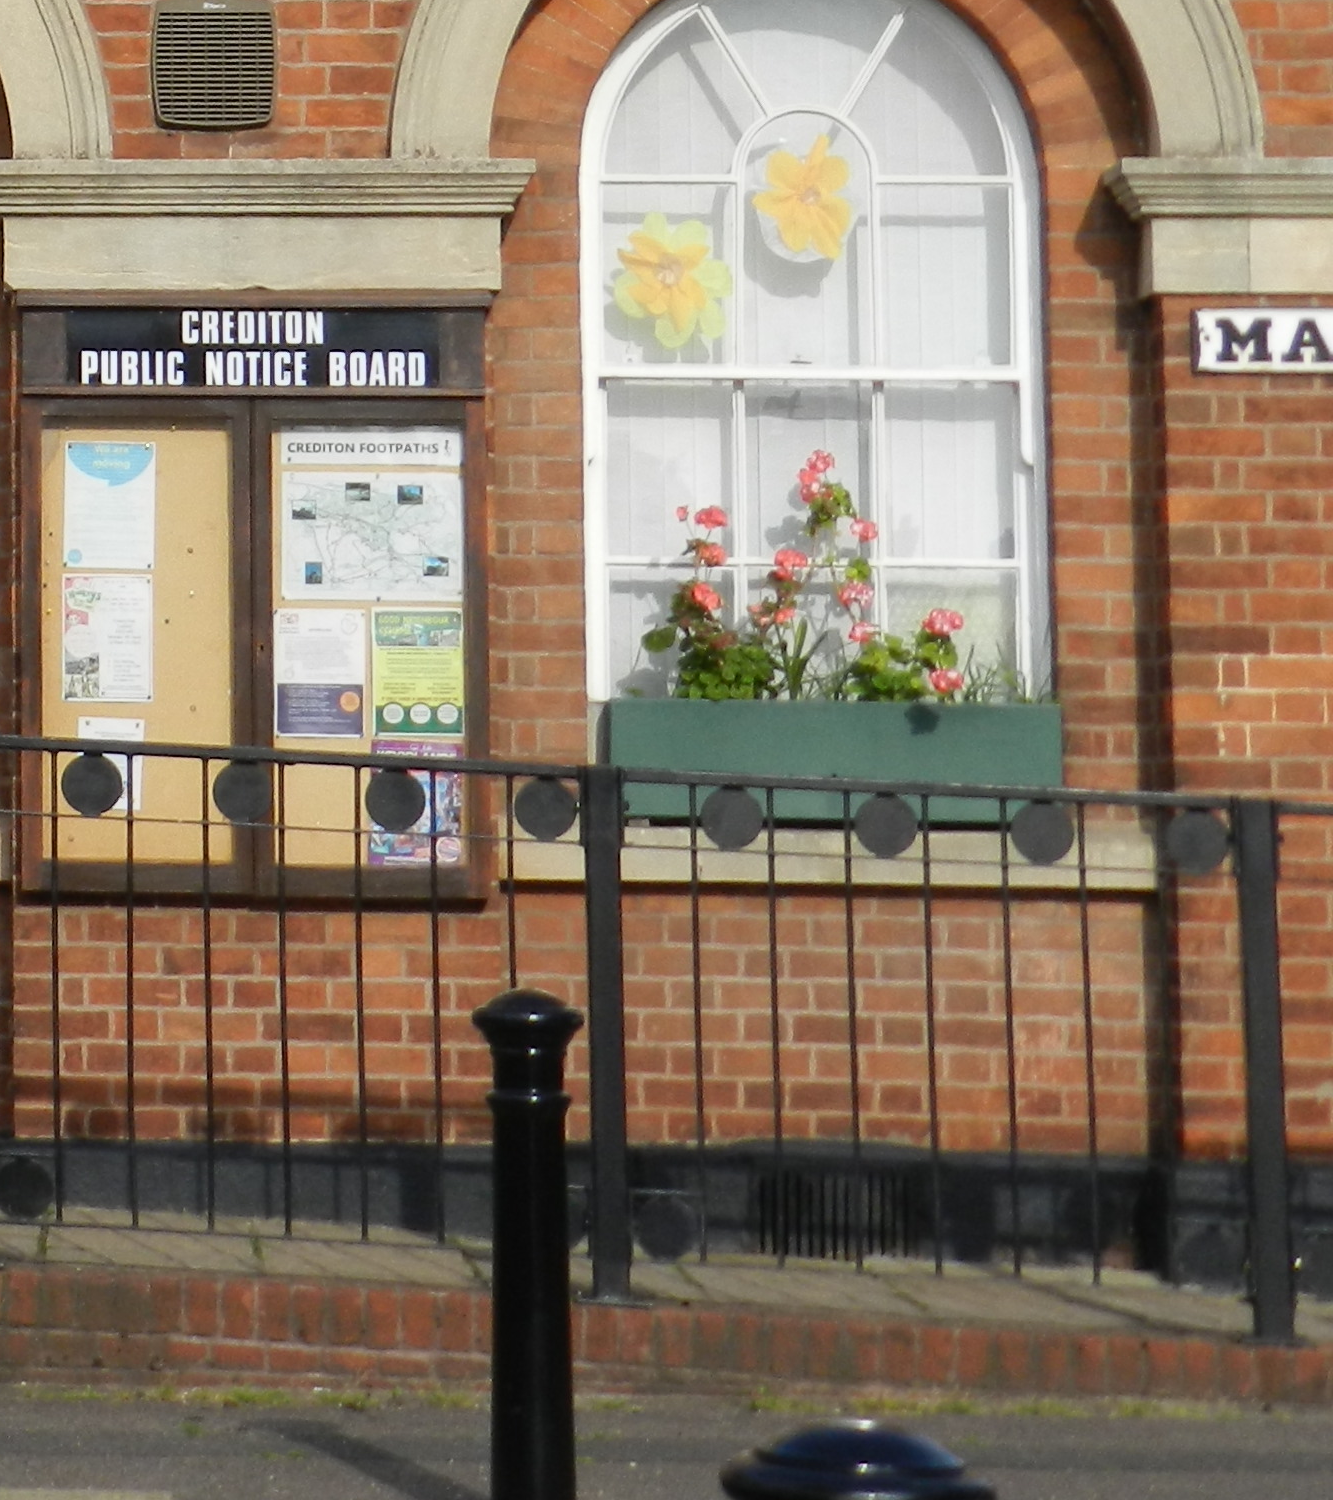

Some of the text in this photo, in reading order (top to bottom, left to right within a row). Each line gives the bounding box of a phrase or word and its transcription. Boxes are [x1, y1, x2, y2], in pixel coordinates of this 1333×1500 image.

[181, 310, 324, 345] CREDITON
[80, 350, 426, 387] PUBLIC NOTICE BOARD
[287, 442, 440, 455] CREDITON FOOTPATHS
